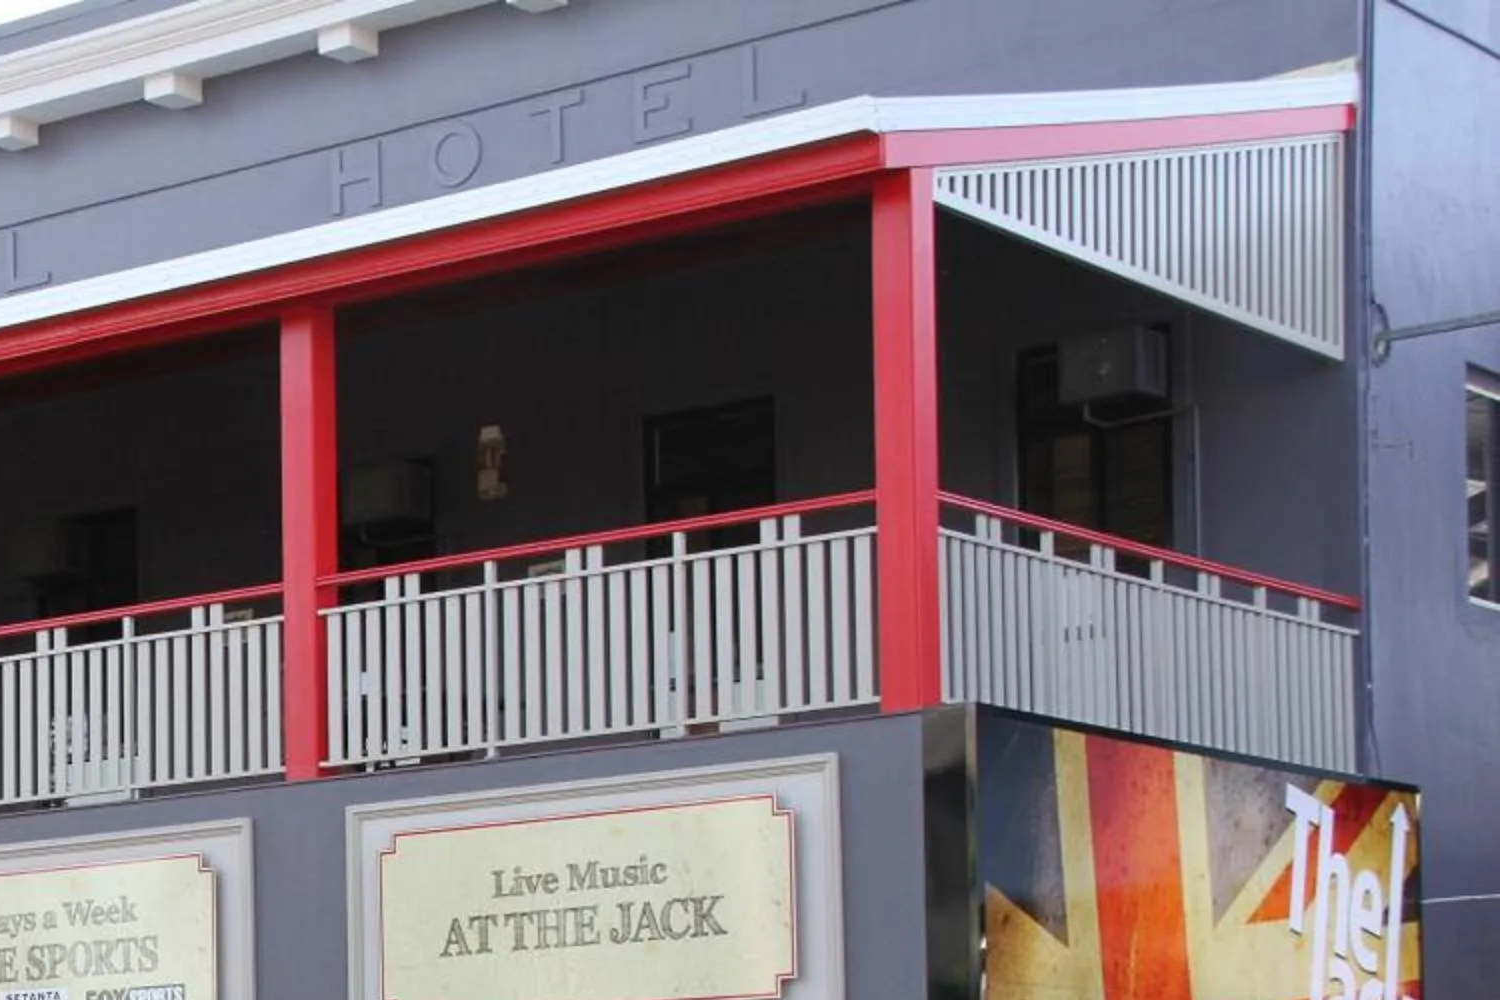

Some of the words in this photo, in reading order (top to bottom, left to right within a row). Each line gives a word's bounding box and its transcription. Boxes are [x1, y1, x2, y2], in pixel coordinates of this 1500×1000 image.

[330, 45, 808, 216] HOTEL
[491, 865, 559, 898] Live
[568, 855, 668, 890] Music
[1286, 783, 1382, 973] The
[43, 913, 57, 930] a
[64, 895, 138, 928] Week
[440, 914, 498, 957] AT
[504, 905, 601, 951] THE
[610, 894, 728, 943] JACK
[22, 935, 160, 980] SPORTS
